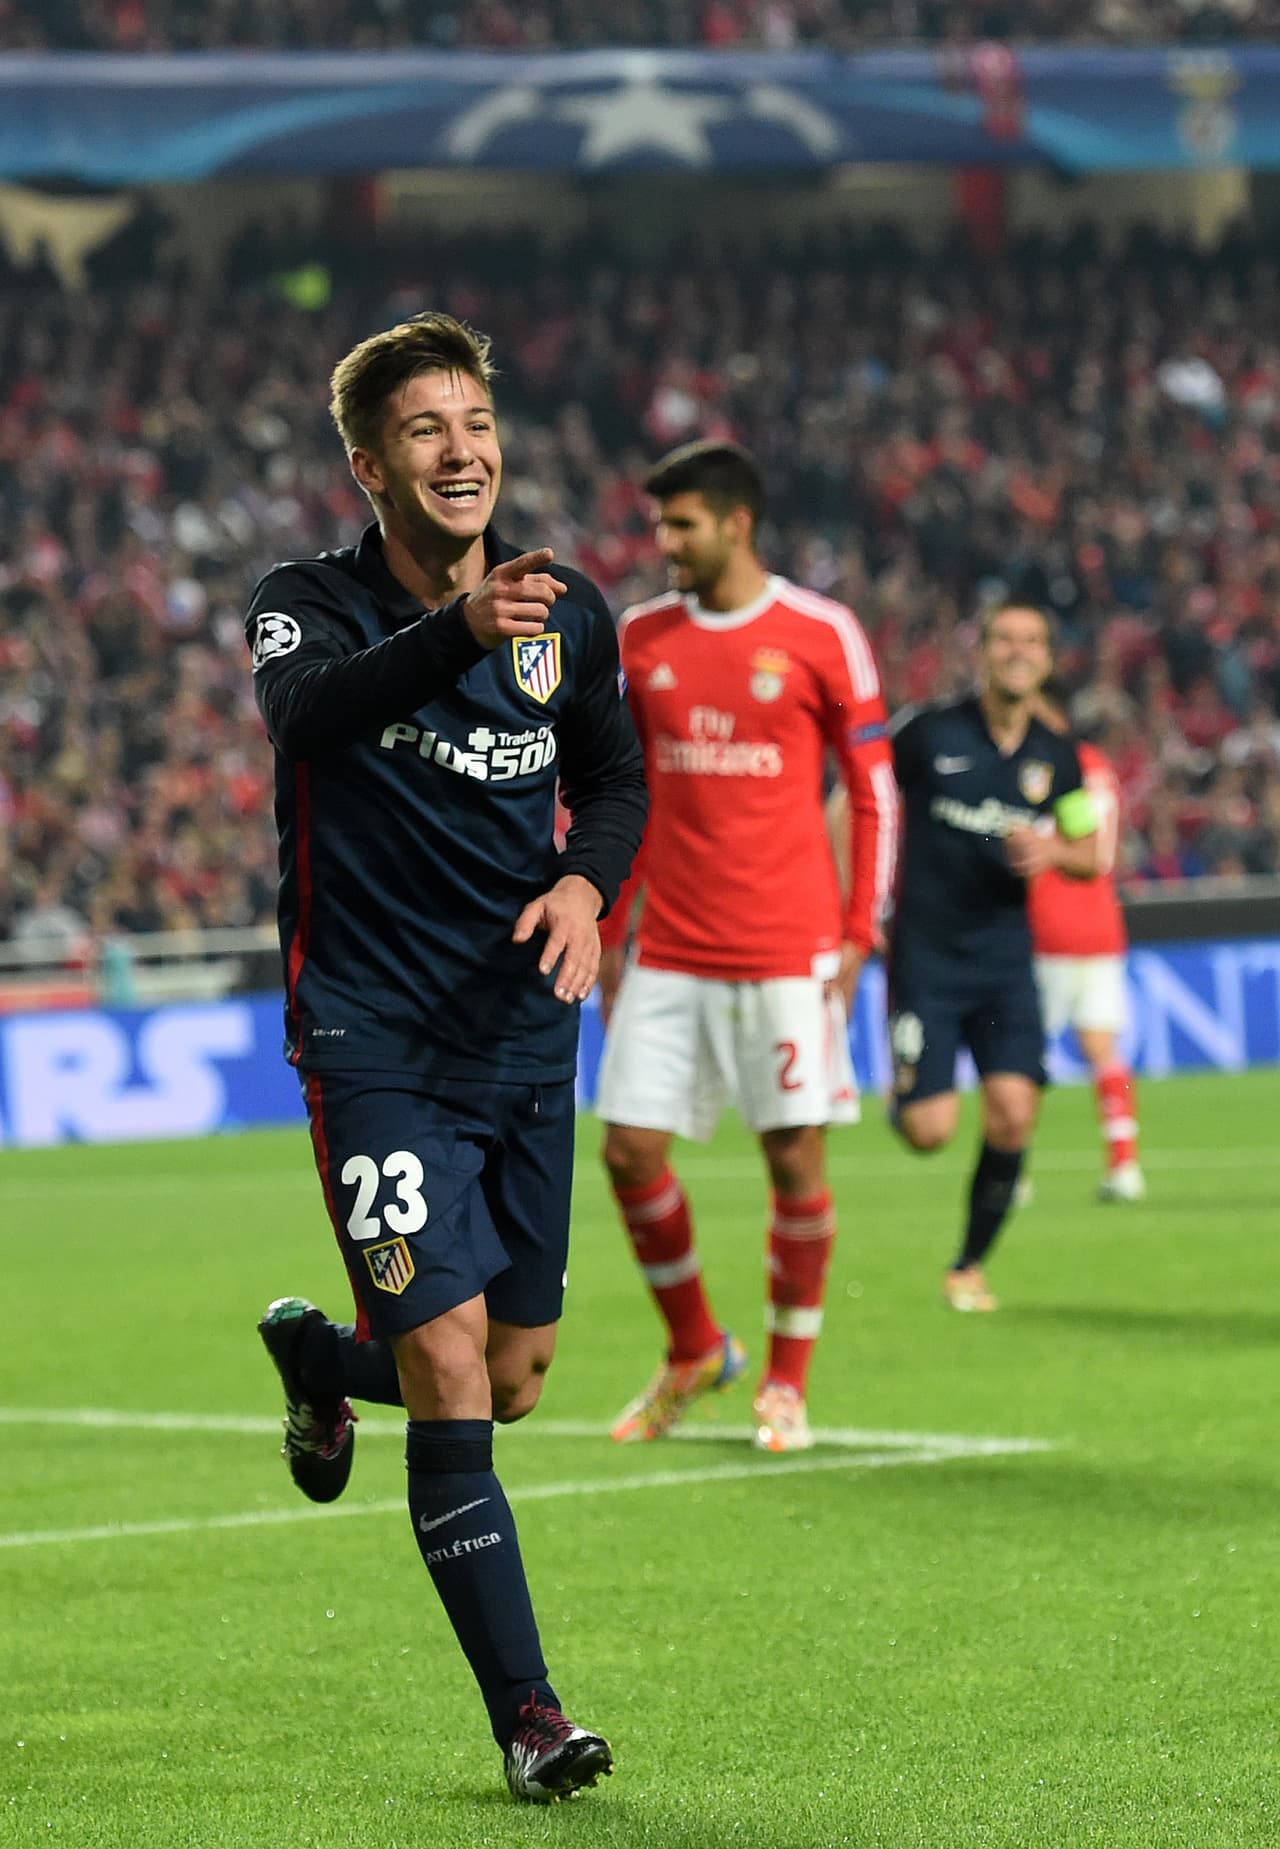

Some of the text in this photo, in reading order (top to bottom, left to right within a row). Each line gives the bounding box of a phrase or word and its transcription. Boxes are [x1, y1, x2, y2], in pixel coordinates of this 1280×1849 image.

[498, 729, 536, 747] Trade
[775, 1041, 803, 1092] 2
[341, 1150, 429, 1241] 23
[426, 1532, 502, 1566] ATLÉTICO
